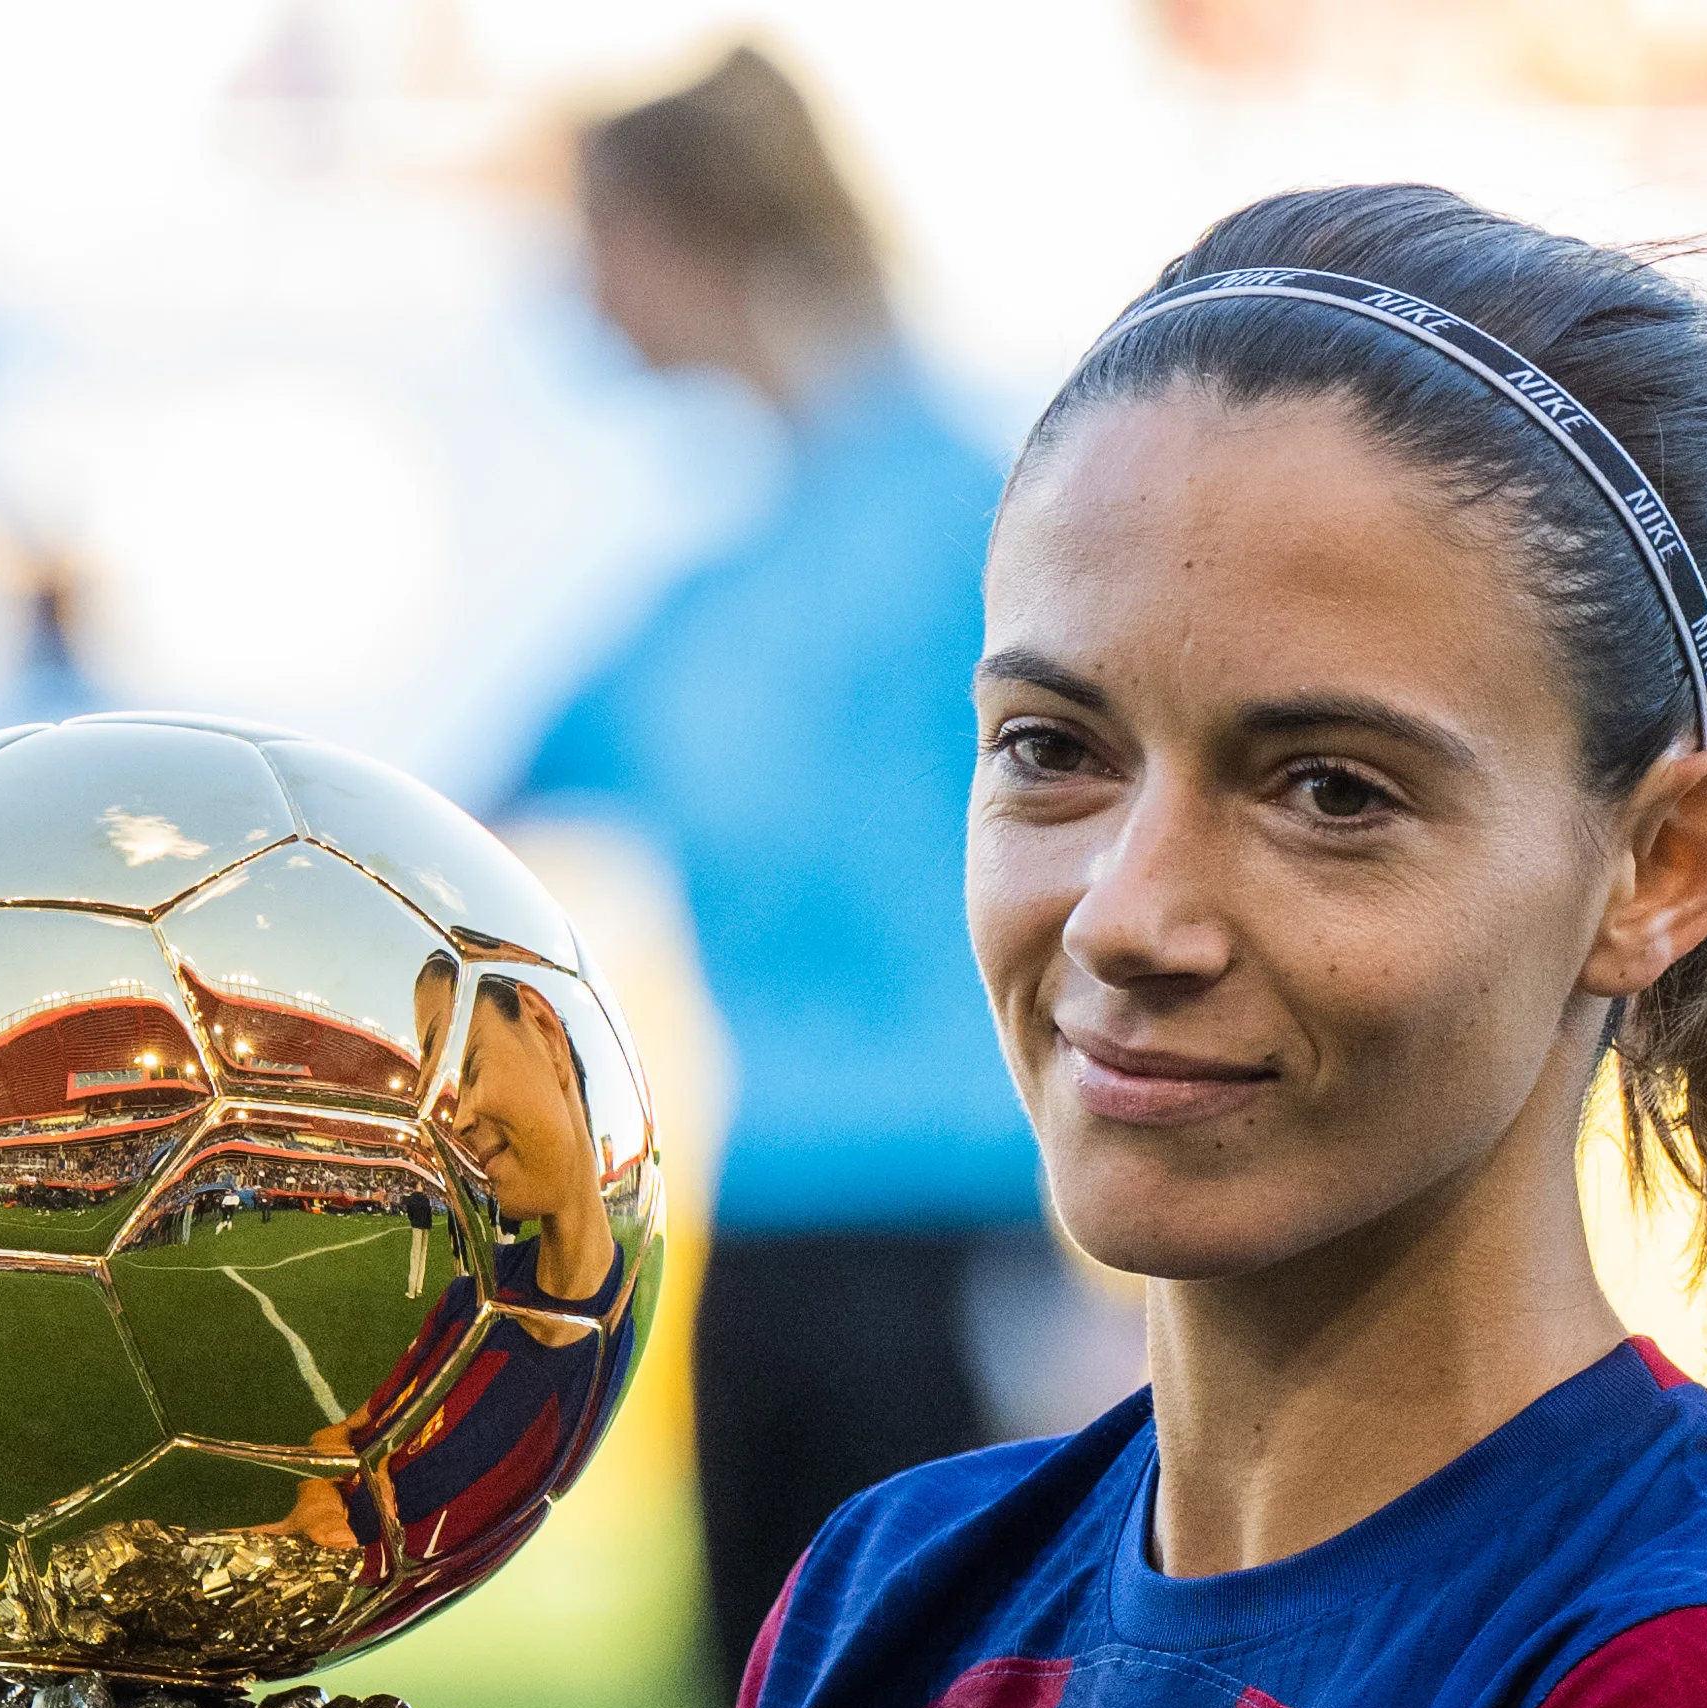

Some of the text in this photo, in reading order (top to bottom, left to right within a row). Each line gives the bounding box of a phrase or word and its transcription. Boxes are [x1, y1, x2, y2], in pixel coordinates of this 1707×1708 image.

[1209, 270, 1307, 290] NIKE
[1361, 291, 1460, 334] NIKE
[1505, 369, 1591, 433] NIKE
[1625, 488, 1682, 563] NIKE
